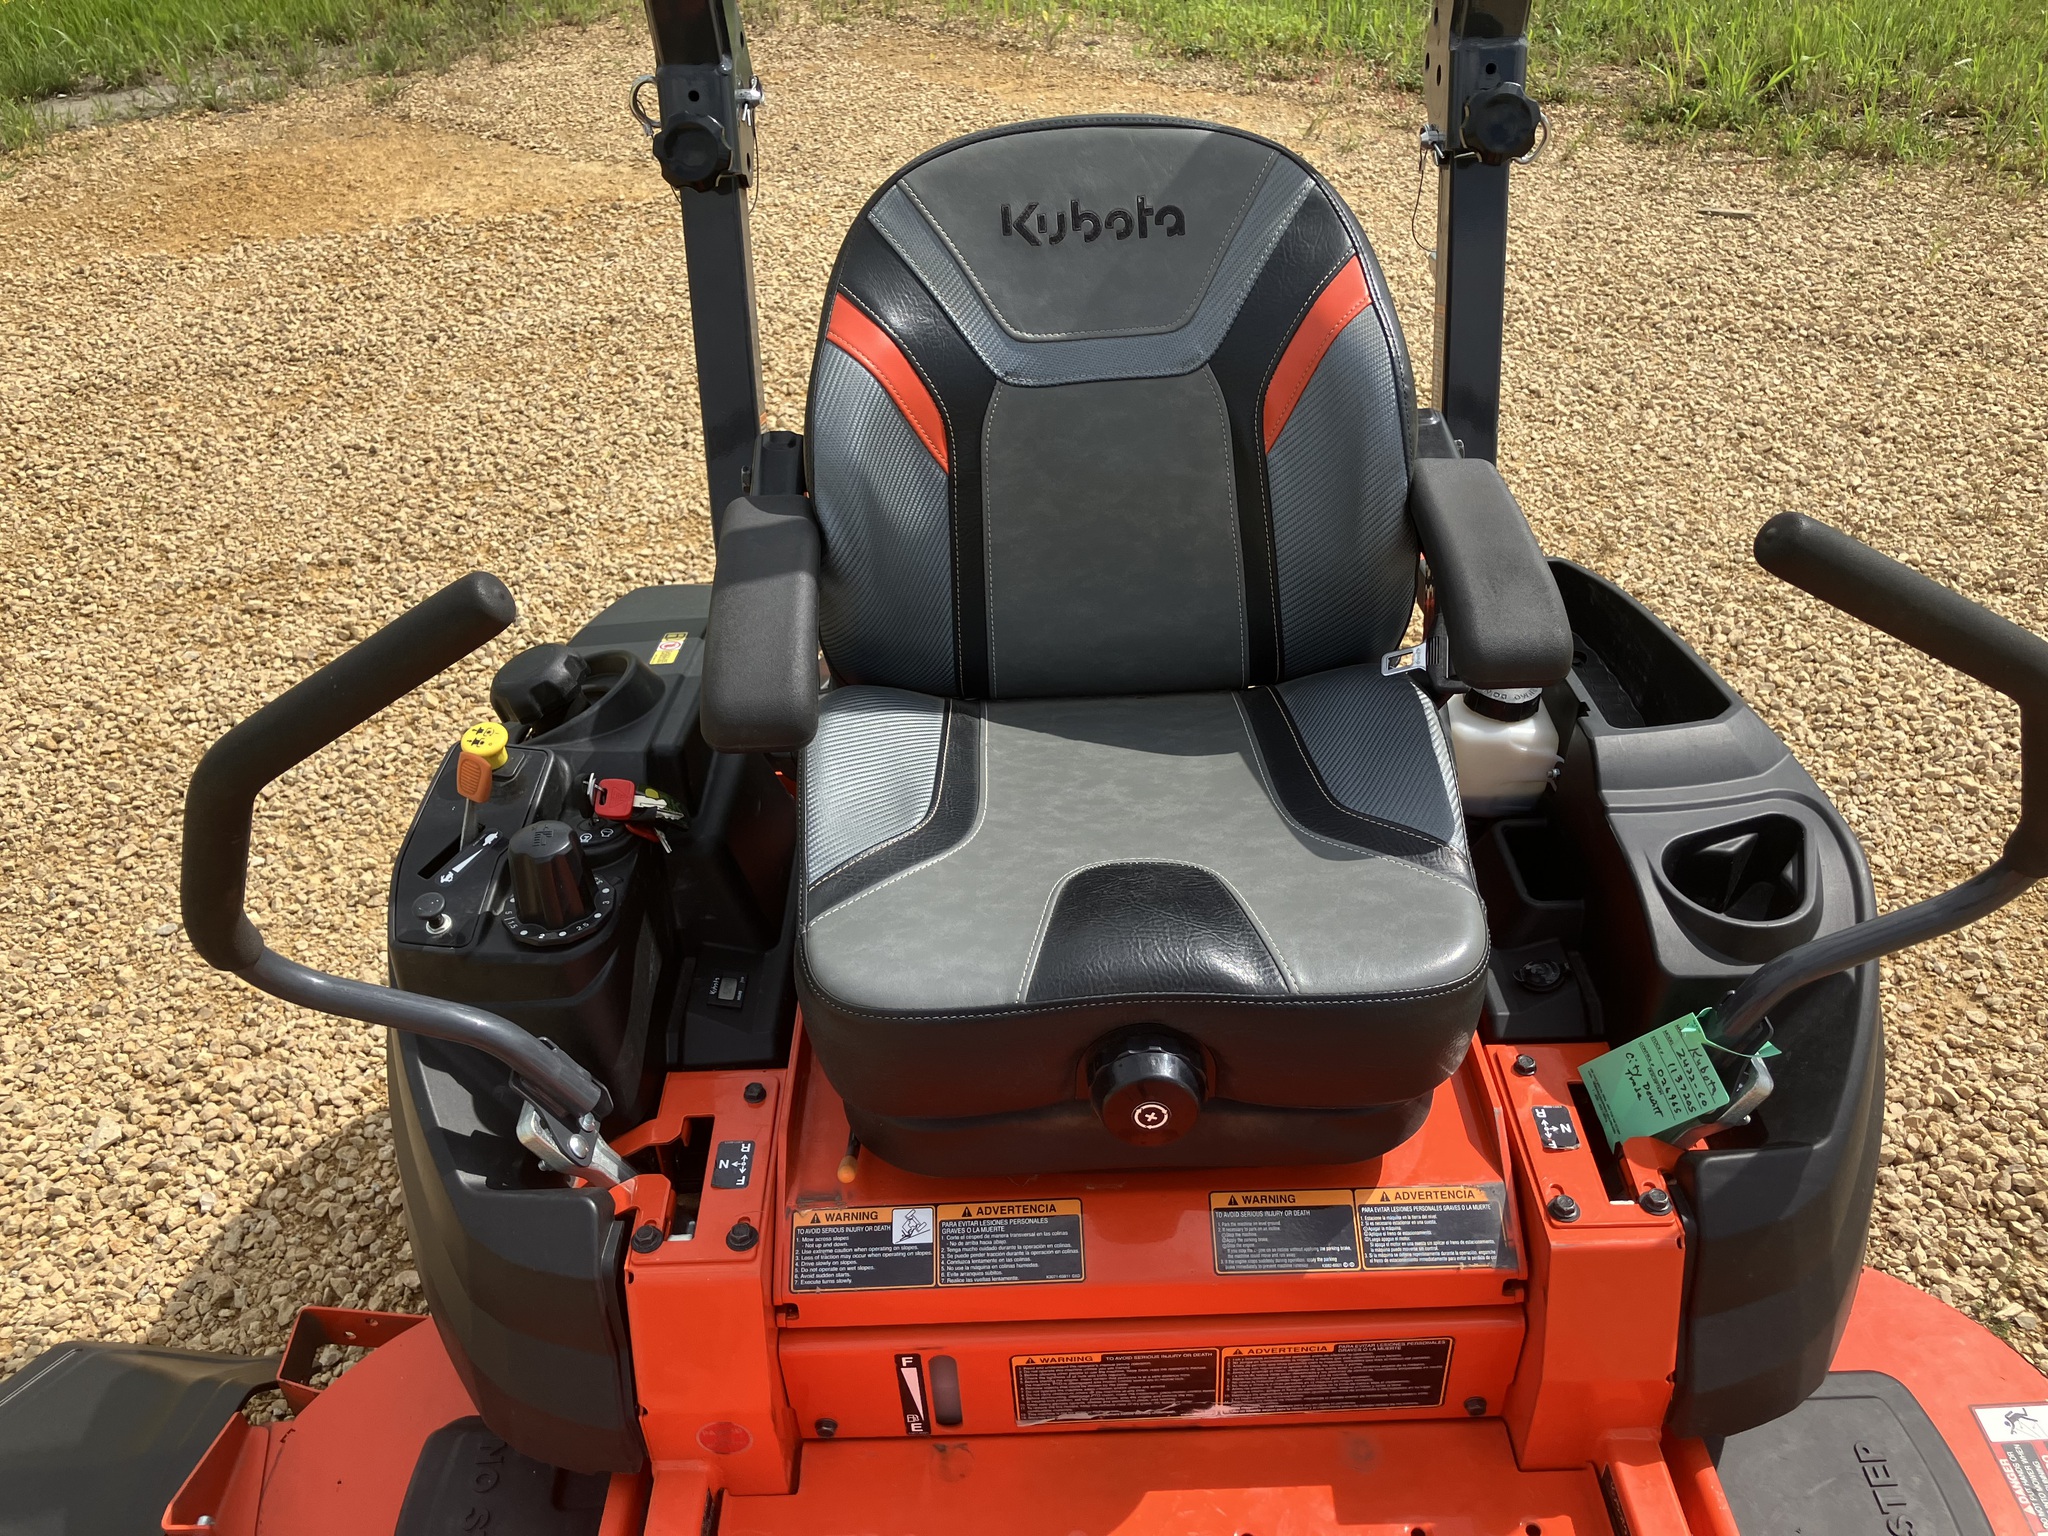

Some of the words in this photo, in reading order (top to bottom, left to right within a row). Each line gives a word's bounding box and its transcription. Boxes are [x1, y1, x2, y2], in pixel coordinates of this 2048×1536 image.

[1001, 195, 1186, 246] Kubota
[576, 922, 590, 932] 2.5
[1690, 1047, 1718, 1095] Kubota
[1535, 1108, 1546, 1118] R
[1560, 1123, 1572, 1133] N
[740, 1143, 751, 1152] R
[718, 1159, 729, 1169] N
[736, 1176, 746, 1185] F
[1242, 1195, 1295, 1203] WARNING
[1393, 1188, 1475, 1201] ADVERTENCIA
[976, 1203, 1056, 1215] ADVERTENCIA
[825, 1211, 878, 1221] WARNING
[1247, 1345, 1327, 1354] ADVERTENCIA
[902, 1356, 913, 1366] F
[910, 1423, 923, 1432] E
[2007, 1451, 2017, 1462] OR
[2014, 1444, 2029, 1464] WHEN
[2013, 1463, 2029, 1487] HANDS
[2024, 1465, 2043, 1492] MOWER
[2000, 1458, 2030, 1504] DANGER
[1854, 1440, 1913, 1536] STEP
[2025, 1487, 2037, 1502] PUT
[2033, 1503, 2045, 1516] NOT
